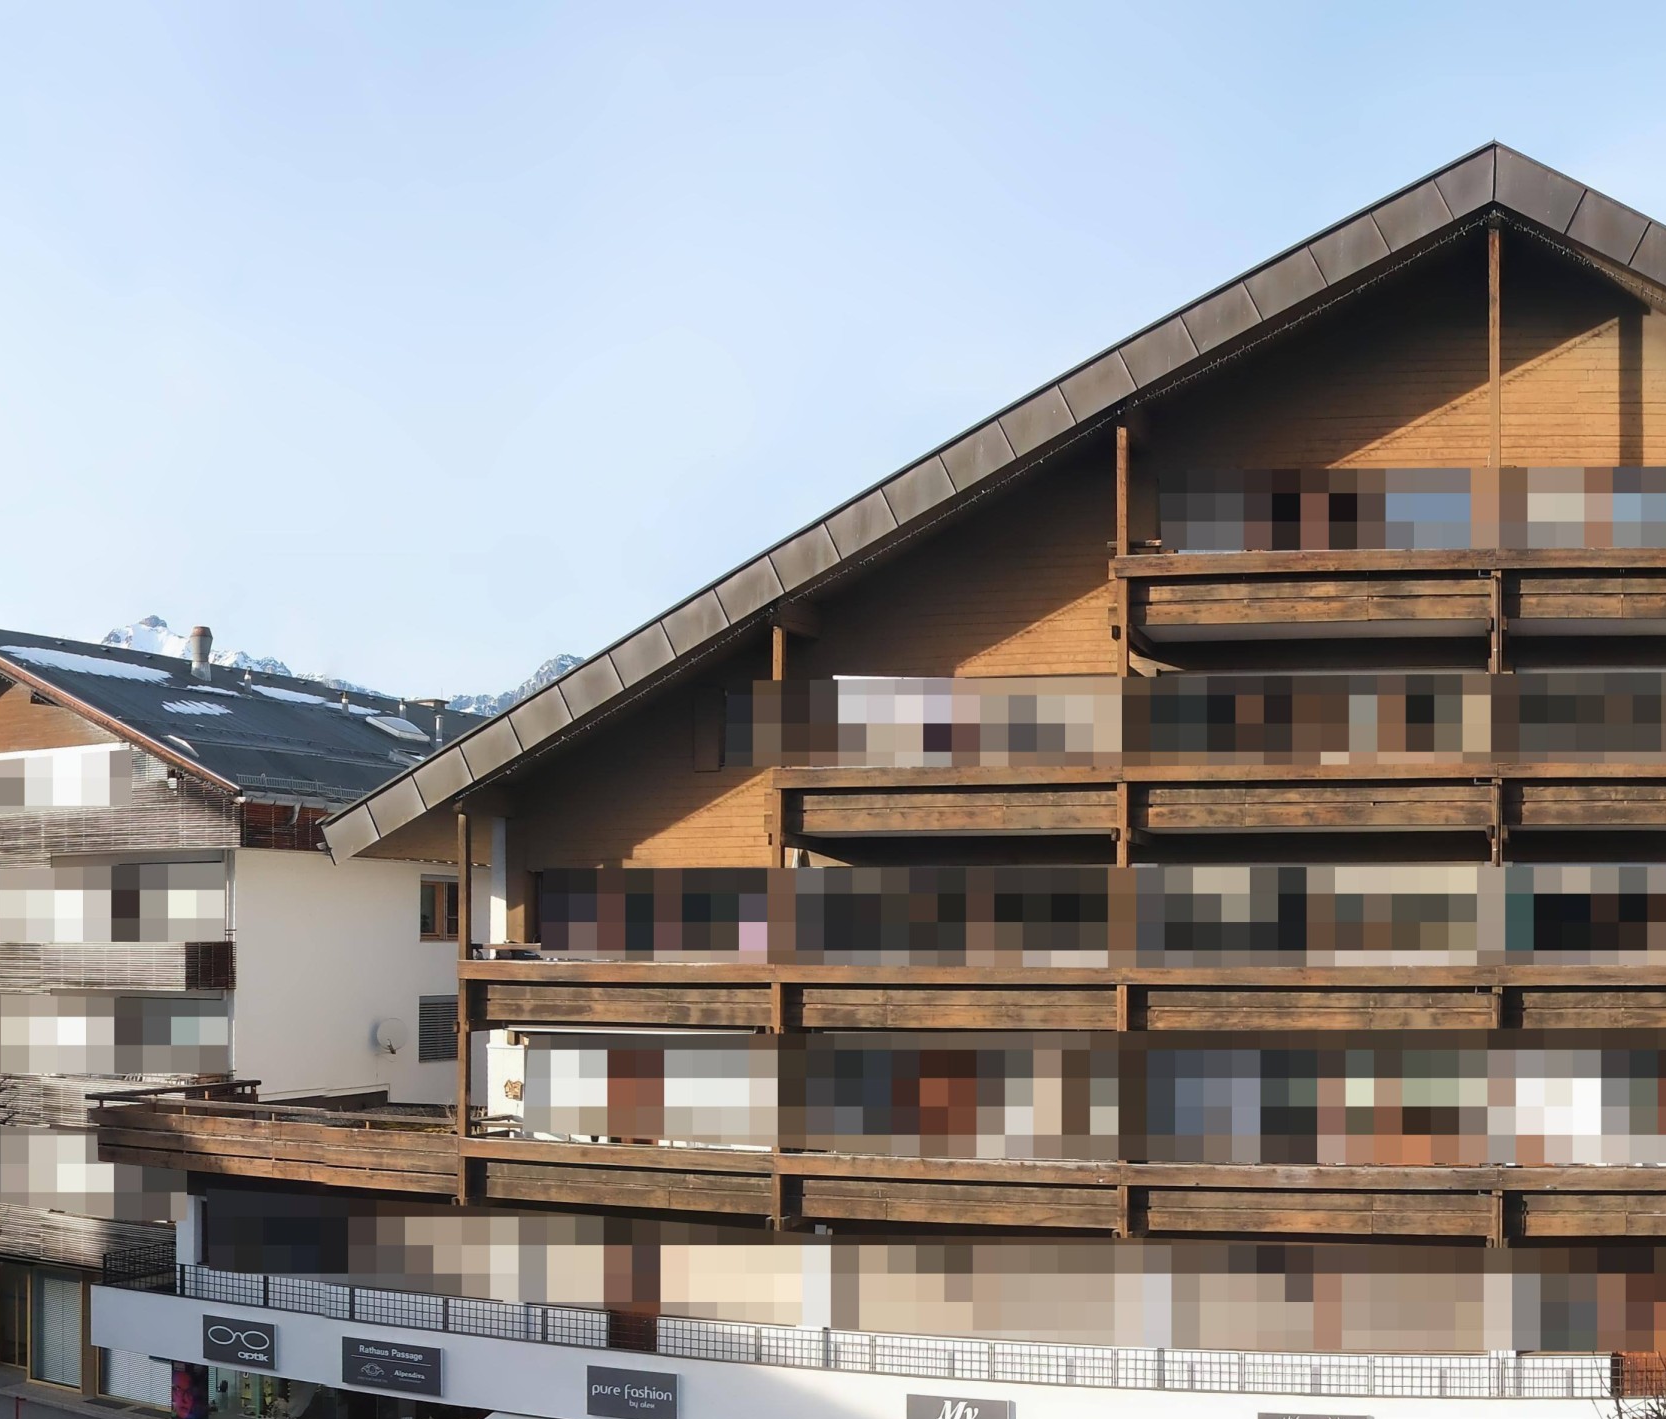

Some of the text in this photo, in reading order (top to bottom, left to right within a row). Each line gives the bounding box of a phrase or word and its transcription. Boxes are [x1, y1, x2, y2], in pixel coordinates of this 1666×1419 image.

[237, 1351, 270, 1363] optik
[359, 1344, 424, 1361] Rathaus Passage
[591, 1383, 673, 1401] pure fashion
[629, 1400, 639, 1409] by
